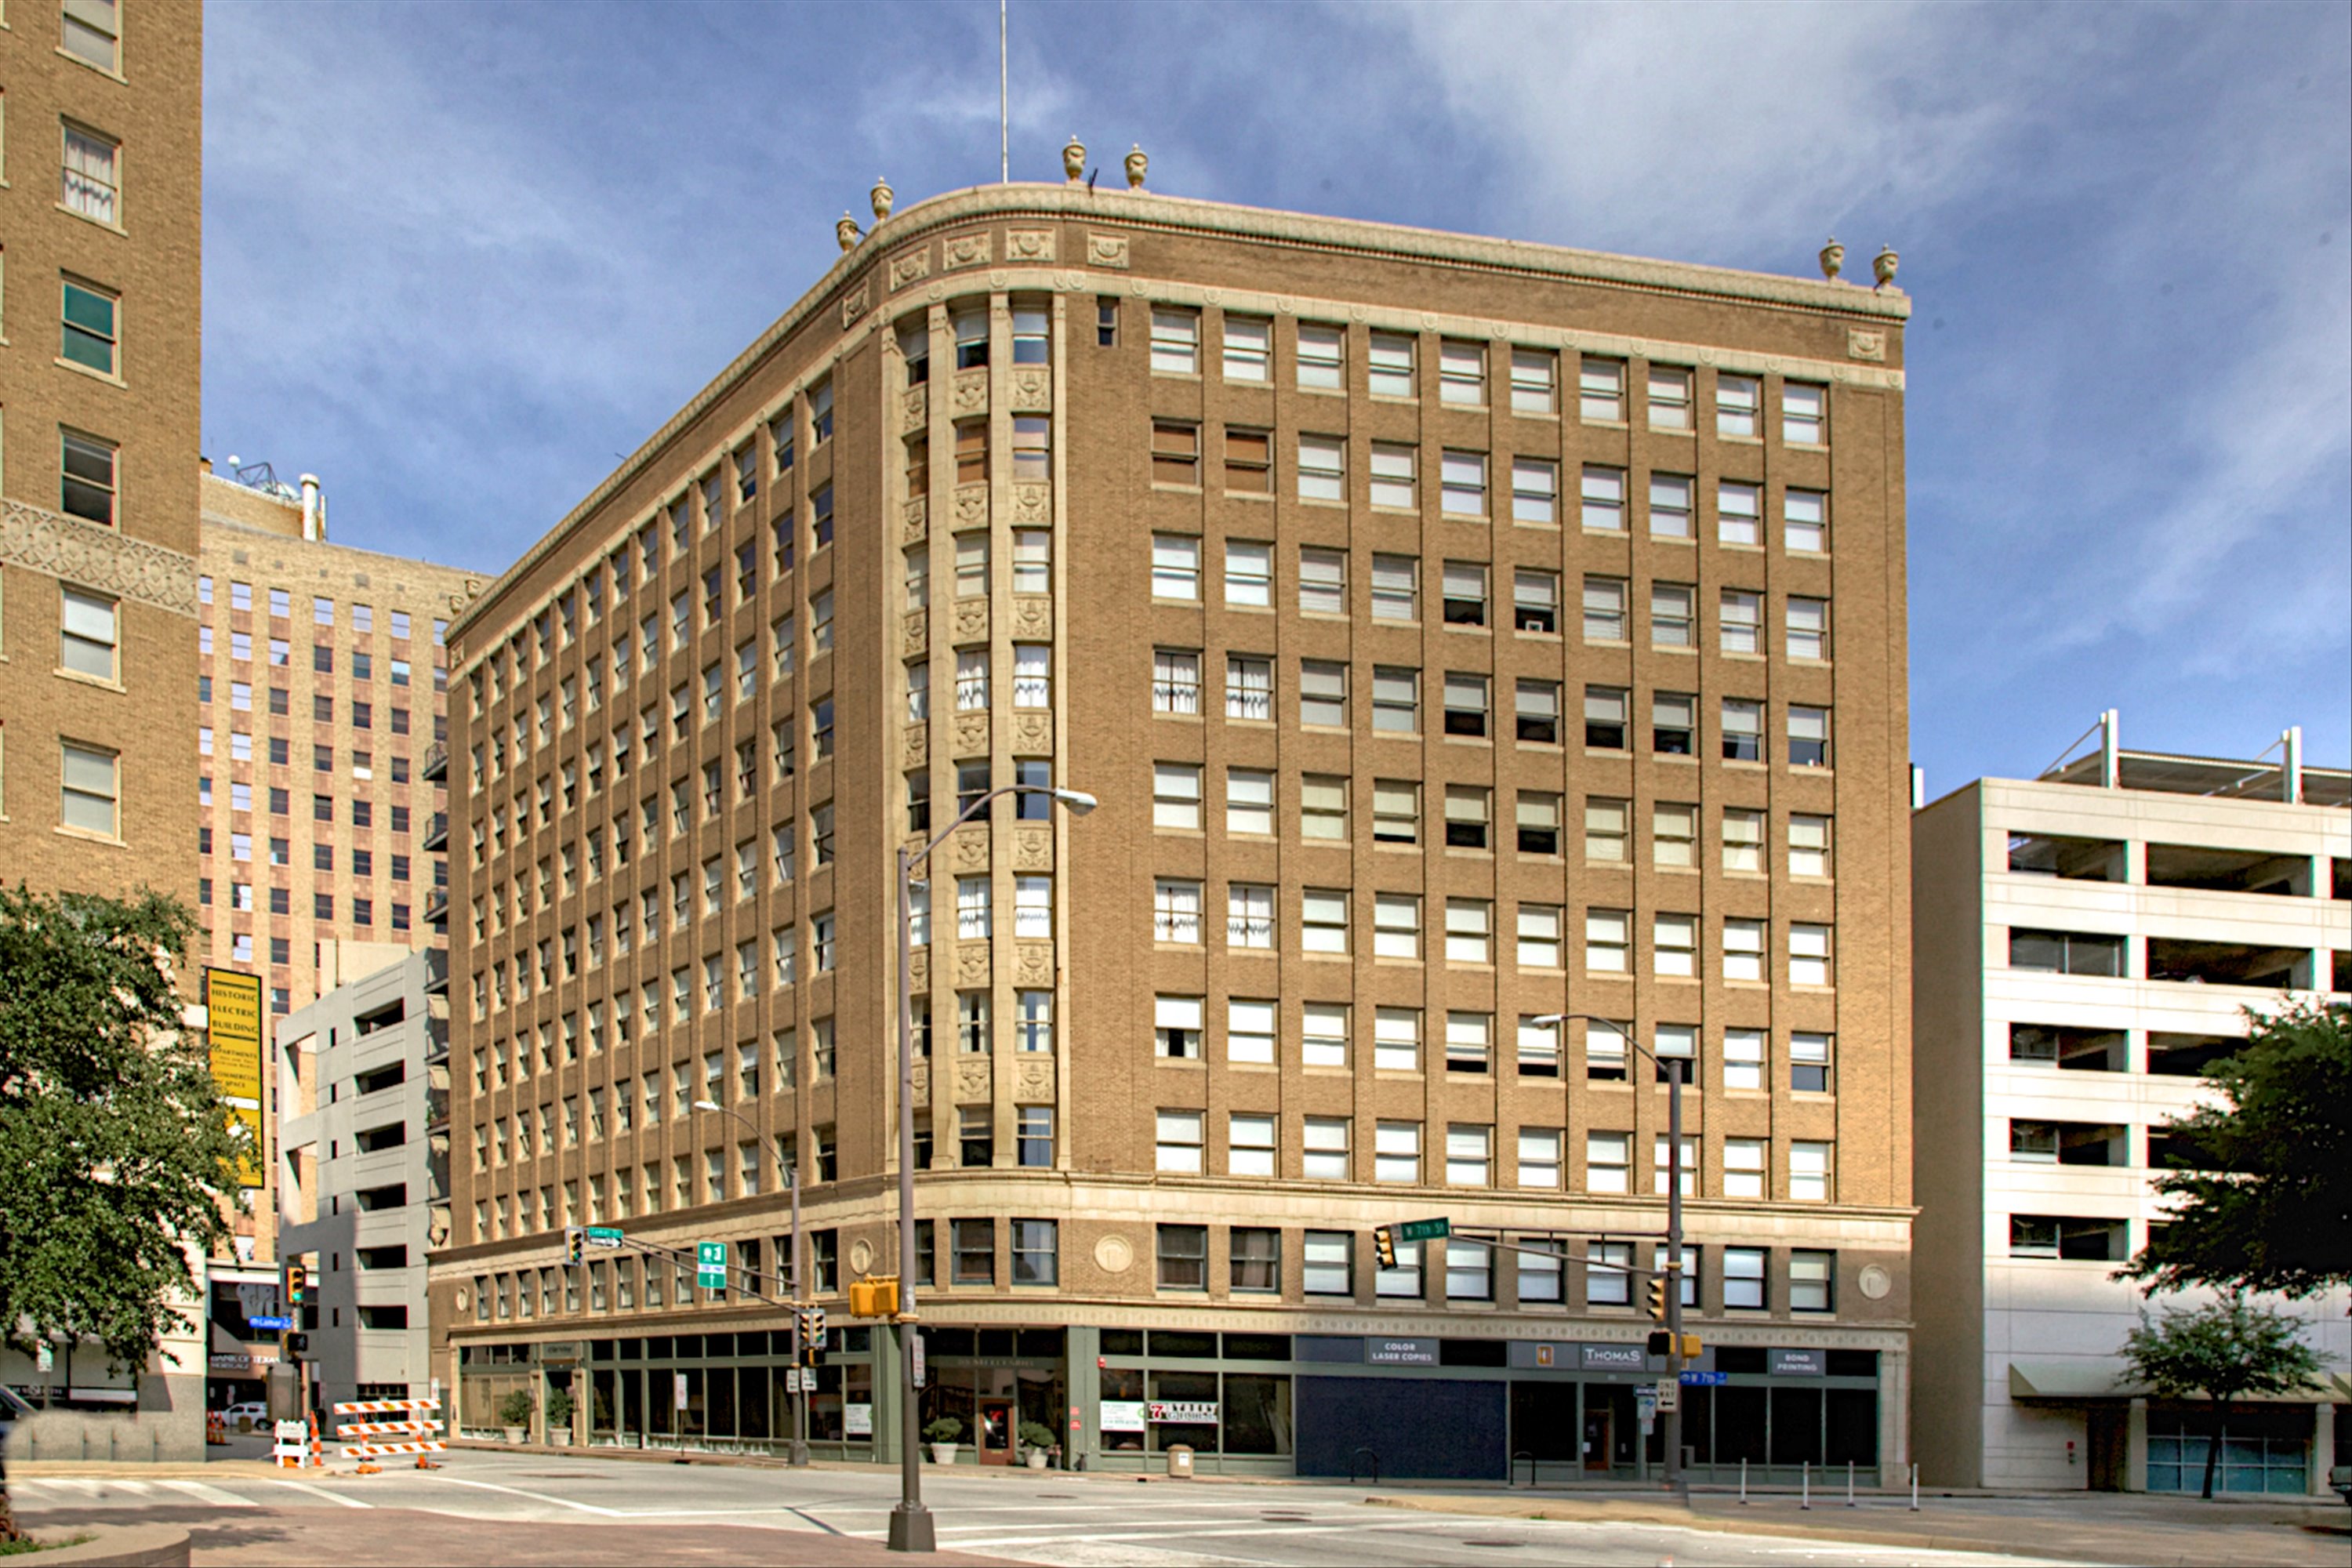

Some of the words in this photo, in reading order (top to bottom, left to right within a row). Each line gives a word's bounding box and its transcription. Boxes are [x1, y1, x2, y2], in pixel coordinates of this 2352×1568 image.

[212, 989, 256, 1002] HISTORIC
[212, 1004, 256, 1018] ELECTRIC
[212, 1020, 257, 1033] BUILDING
[259, 1318, 281, 1327] Lamar
[1584, 1348, 1641, 1361] THOMAS
[1701, 1374, 1715, 1383] 7th
[1660, 1381, 1675, 1390] ONE
[1150, 1404, 1163, 1418] 7
